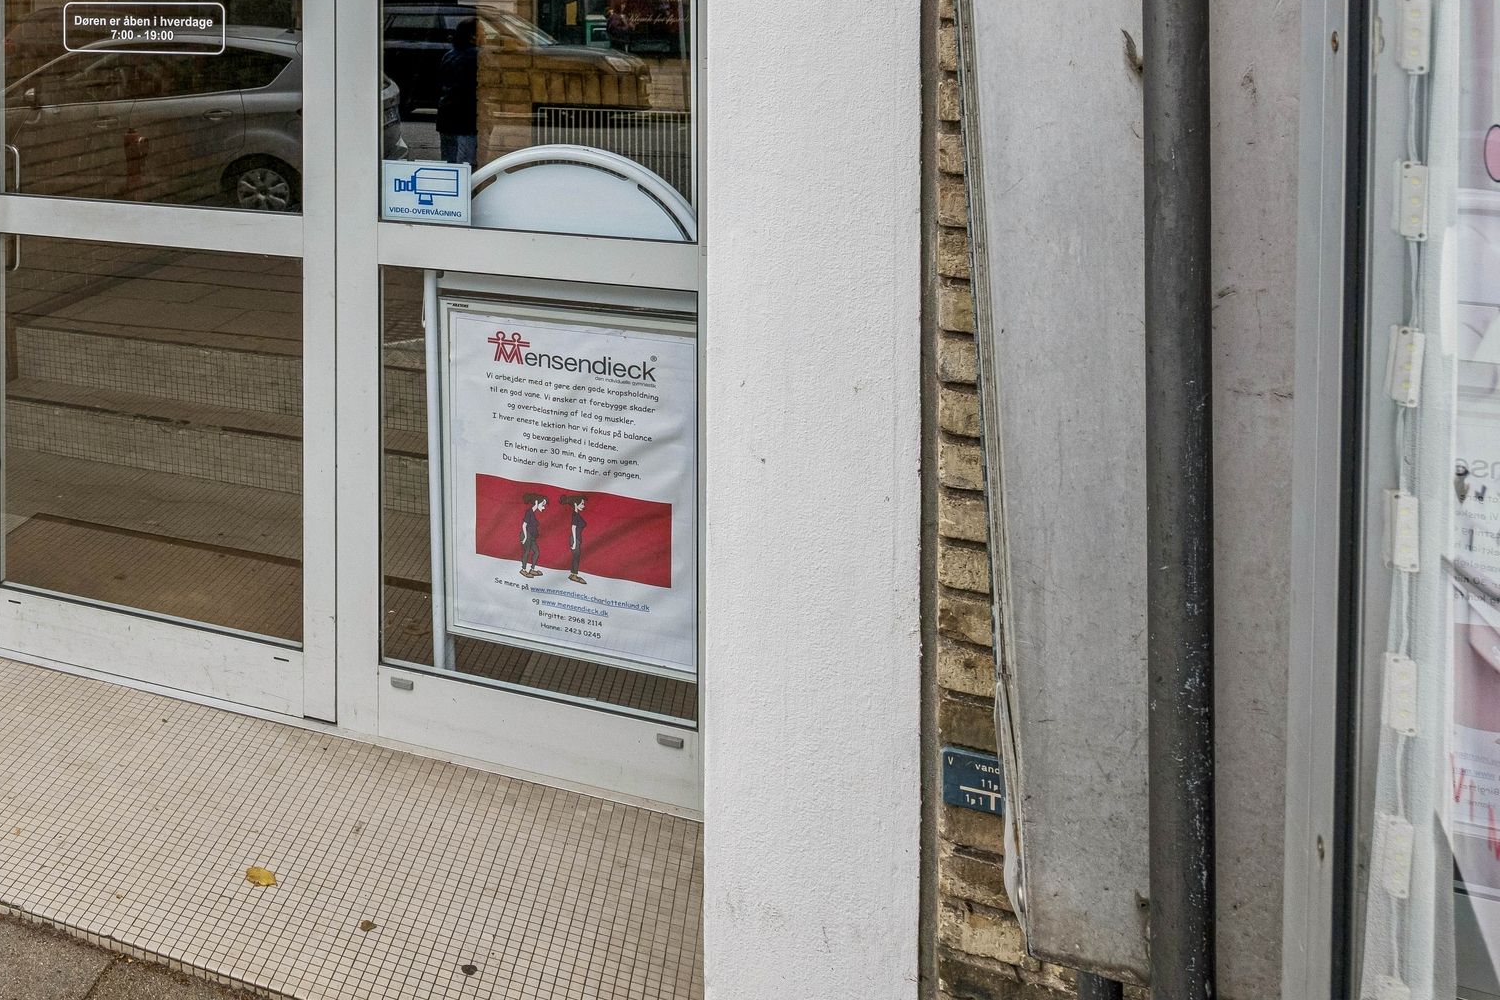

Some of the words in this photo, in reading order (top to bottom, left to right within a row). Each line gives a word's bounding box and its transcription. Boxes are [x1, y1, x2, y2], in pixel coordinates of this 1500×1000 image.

[74, 16, 106, 26] Døren
[109, 18, 120, 26] er
[124, 16, 150, 27] åben
[160, 16, 213, 29] hverdage
[111, 30, 133, 40] 7:00
[145, 30, 174, 40] 19:00
[389, 206, 462, 218] VIDEO-OVERVÅGNING
[495, 374, 526, 384] arbejder
[554, 382, 570, 391] gøre
[588, 386, 605, 394] gode
[607, 387, 659, 402] kropsholdning
[510, 389, 522, 398] god
[524, 392, 541, 400] vane.
[544, 393, 551, 401] Vi
[553, 395, 577, 404] ønsker
[590, 399, 627, 411] forebygge
[630, 404, 655, 413] skader
[518, 404, 568, 417] overbelastning
[605, 415, 635, 425] muskler.
[499, 413, 514, 421] hver
[517, 416, 539, 426] eneste
[541, 419, 565, 429] lektion
[590, 427, 611, 437] fokus
[613, 430, 622, 439] på
[624, 432, 652, 442] balance
[532, 433, 581, 445] bevægelighed
[588, 440, 618, 451] leddene.
[515, 441, 538, 453] lektion
[562, 449, 576, 457] min.
[588, 454, 605, 465] gang
[620, 458, 639, 467] ugen.
[513, 455, 535, 466] binder
[538, 459, 549, 469] dig
[551, 460, 563, 468] kun
[584, 467, 600, 476] mdr.
[613, 471, 641, 480] gangen.
[504, 579, 519, 588] mere
[521, 583, 529, 591] på
[539, 611, 566, 621] Birgitte:
[568, 615, 585, 625] 2968
[587, 618, 602, 627] 2114
[541, 623, 562, 632] Hanne:
[565, 626, 581, 635] 2423
[583, 629, 601, 639] 0245
[948, 756, 953, 765] V
